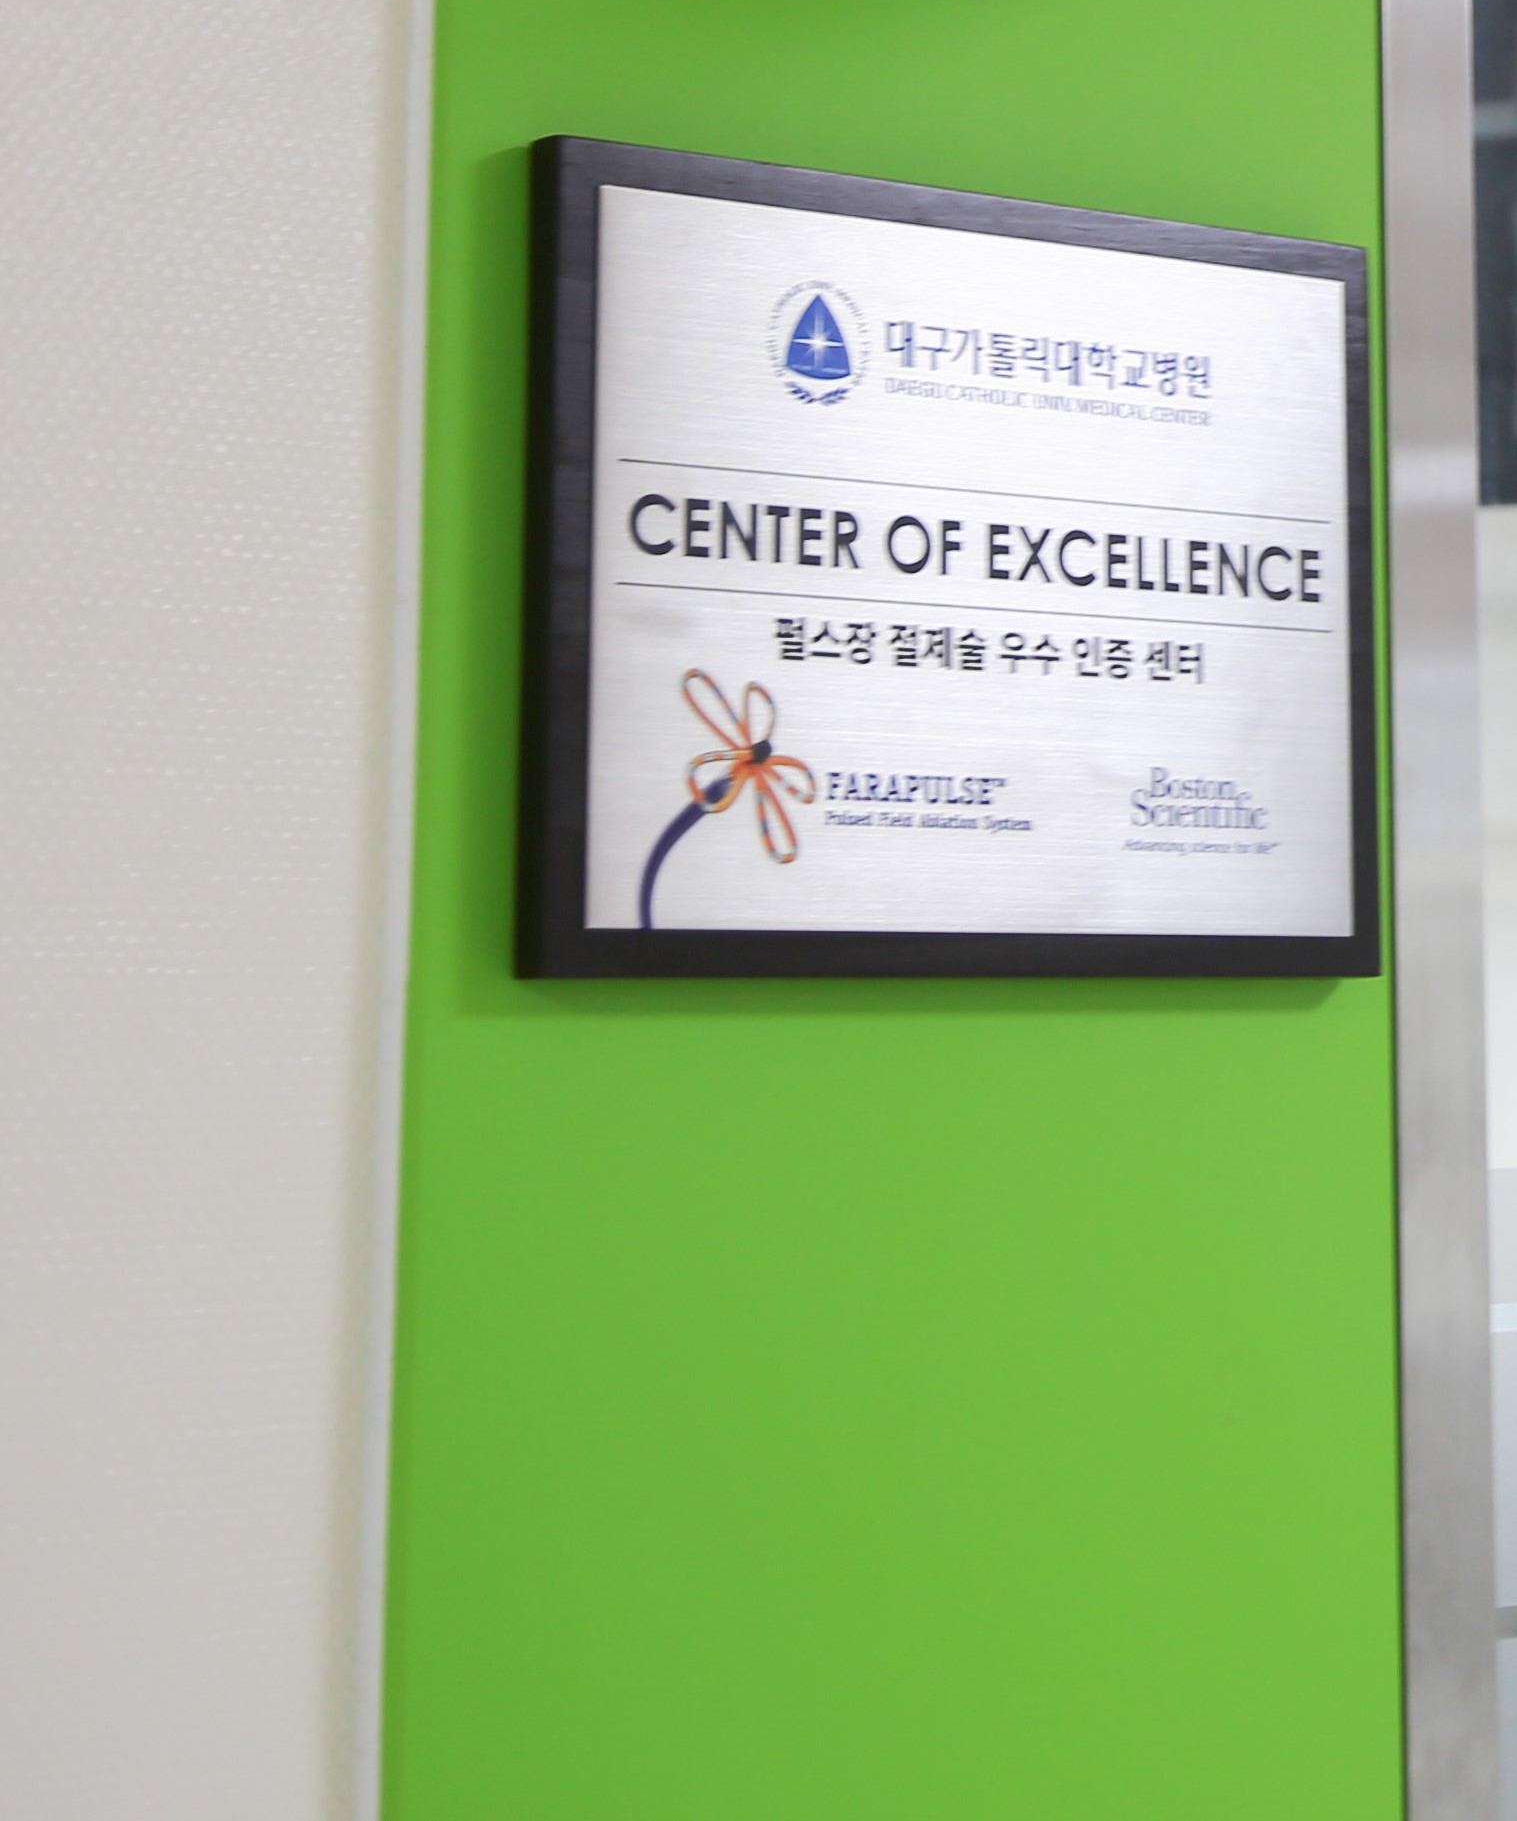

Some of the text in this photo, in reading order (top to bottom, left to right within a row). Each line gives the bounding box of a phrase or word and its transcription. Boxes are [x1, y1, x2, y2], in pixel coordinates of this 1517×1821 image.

[887, 321, 1212, 399] 대구가톨릭대학교병원
[629, 493, 1321, 603] CENTER OF EXCELLENCE
[774, 616, 1205, 684] 펄스장 절제술 우수 인증 센터
[1131, 789, 1268, 830] Scientific
[1149, 766, 1236, 800] Boston
